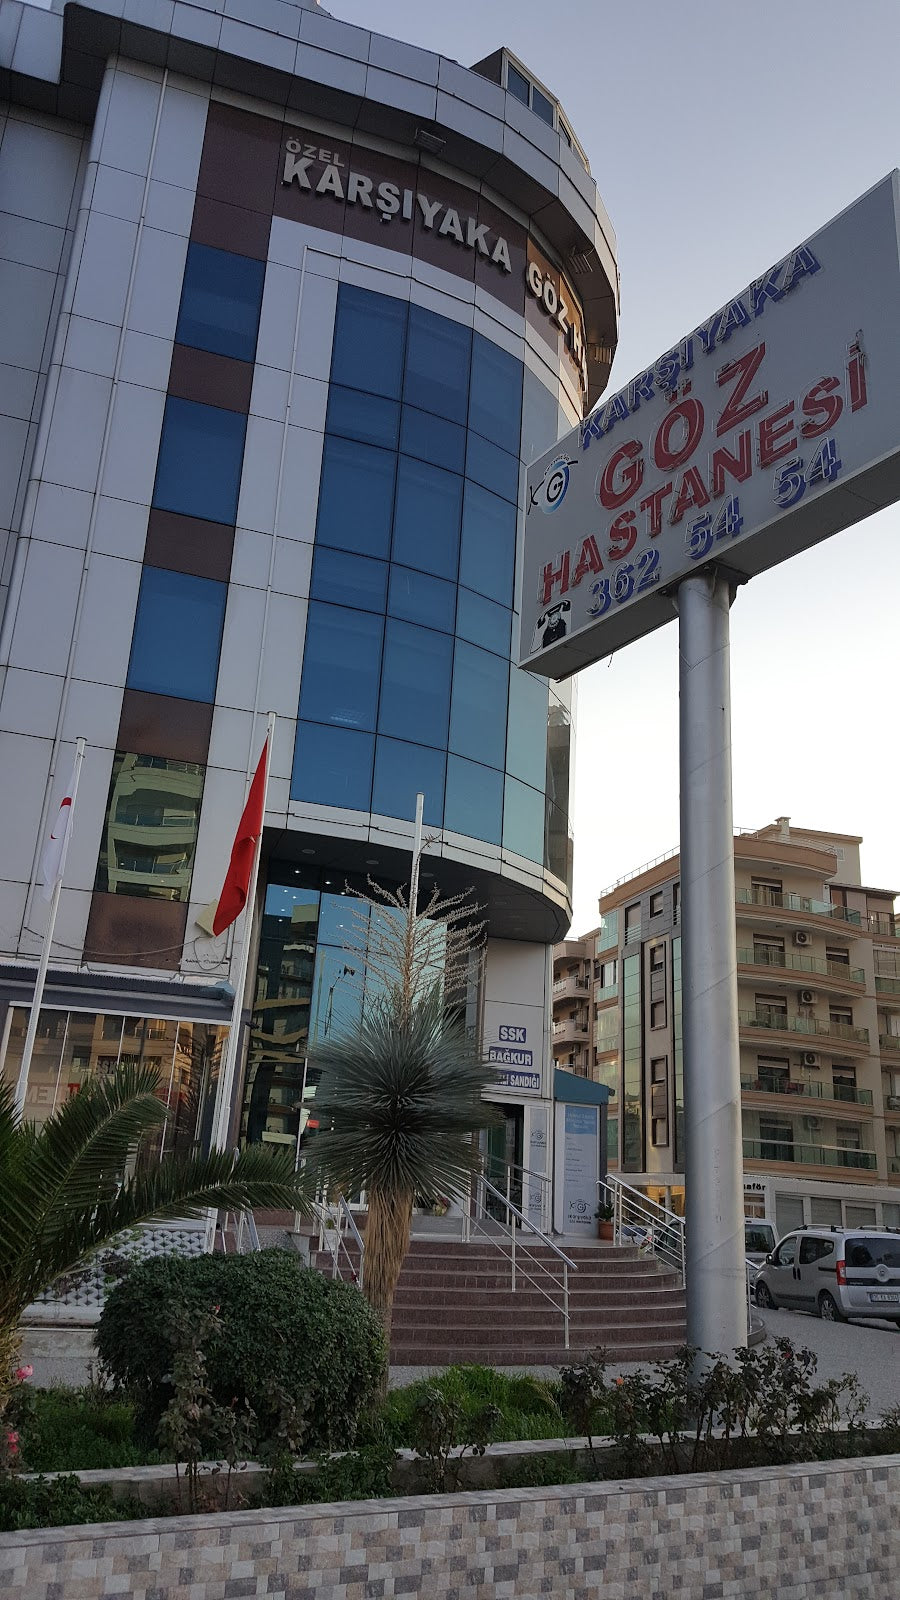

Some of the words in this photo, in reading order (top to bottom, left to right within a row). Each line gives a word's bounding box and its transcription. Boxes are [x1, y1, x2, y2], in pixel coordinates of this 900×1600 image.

[285, 136, 344, 168] ÖZEL
[282, 152, 512, 273] KARŞIYAKA
[526, 262, 569, 334] GÖZ
[578, 246, 822, 450] KARŞIYAKA
[596, 341, 769, 510] GÖZ
[538, 344, 868, 606] HASTANESİ
[586, 547, 661, 617] 362
[685, 493, 744, 560] 54
[772, 436, 842, 509] 54
[489, 1047, 532, 1066] BAĞKUR
[500, 1026, 526, 1042] SSK
[510, 1074, 540, 1089] SANDIĞI
